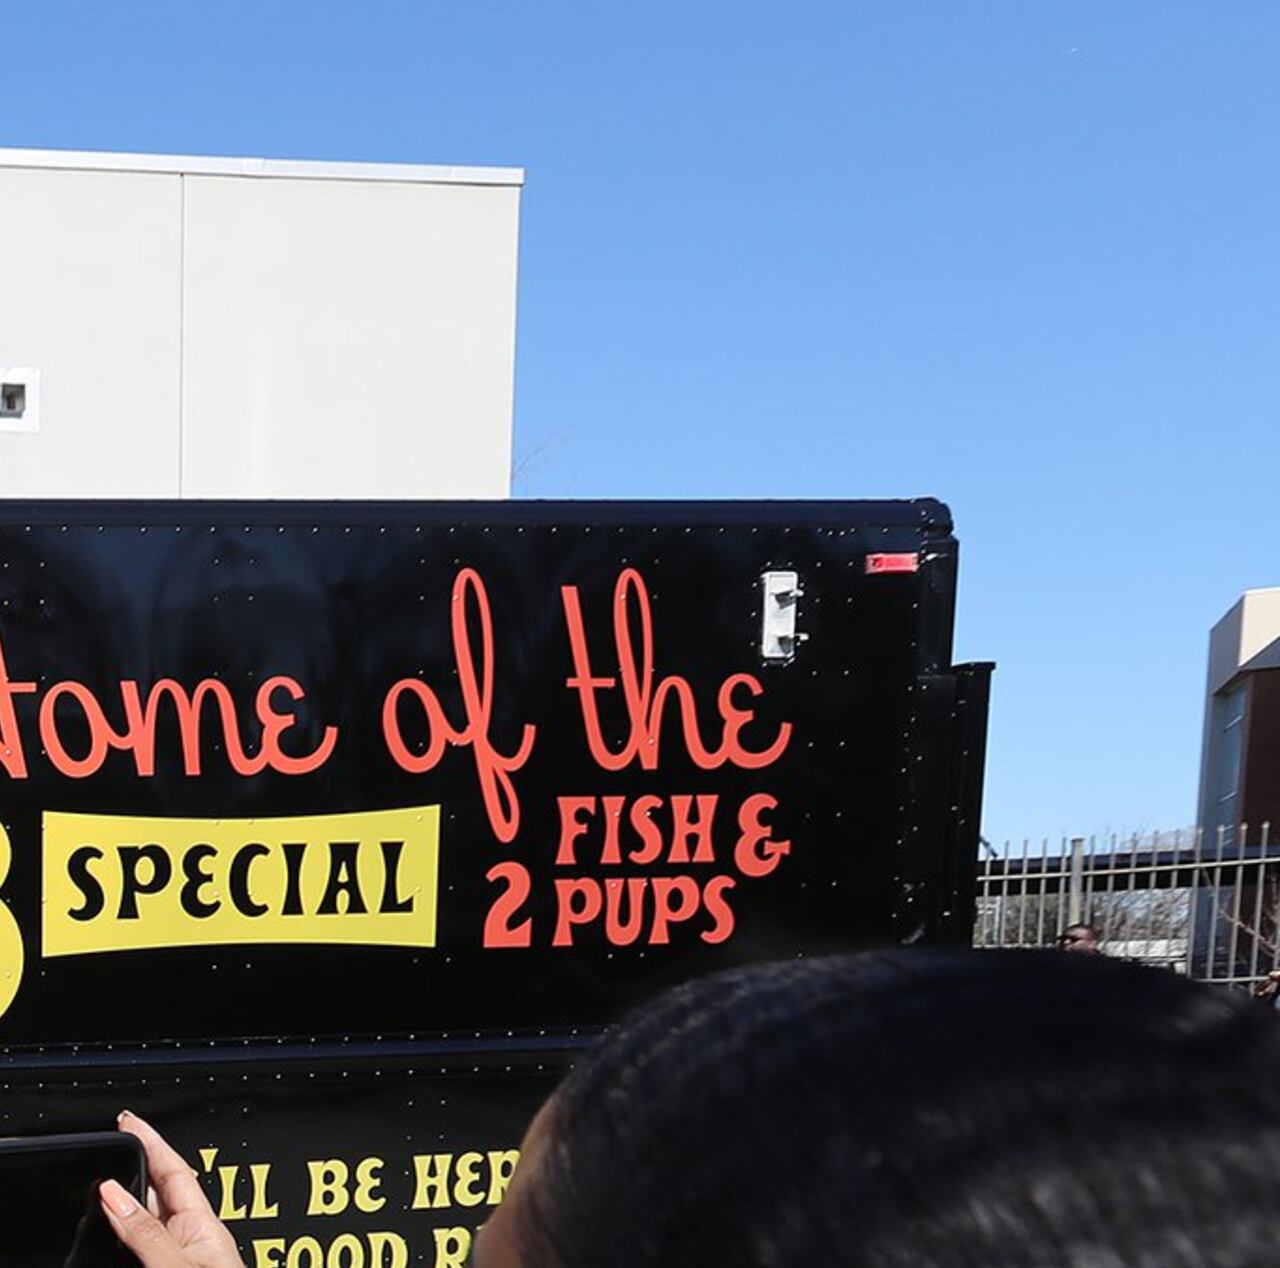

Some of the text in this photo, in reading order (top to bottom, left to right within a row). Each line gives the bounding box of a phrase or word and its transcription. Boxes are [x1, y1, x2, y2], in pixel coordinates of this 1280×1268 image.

[381, 567, 536, 844] of
[561, 567, 793, 771] the
[555, 793, 792, 878] FISH &
[67, 839, 415, 923] SPECIAL
[483, 861, 737, 949] 2 PUPS
[192, 1147, 522, 1221] 'LL BE HER
